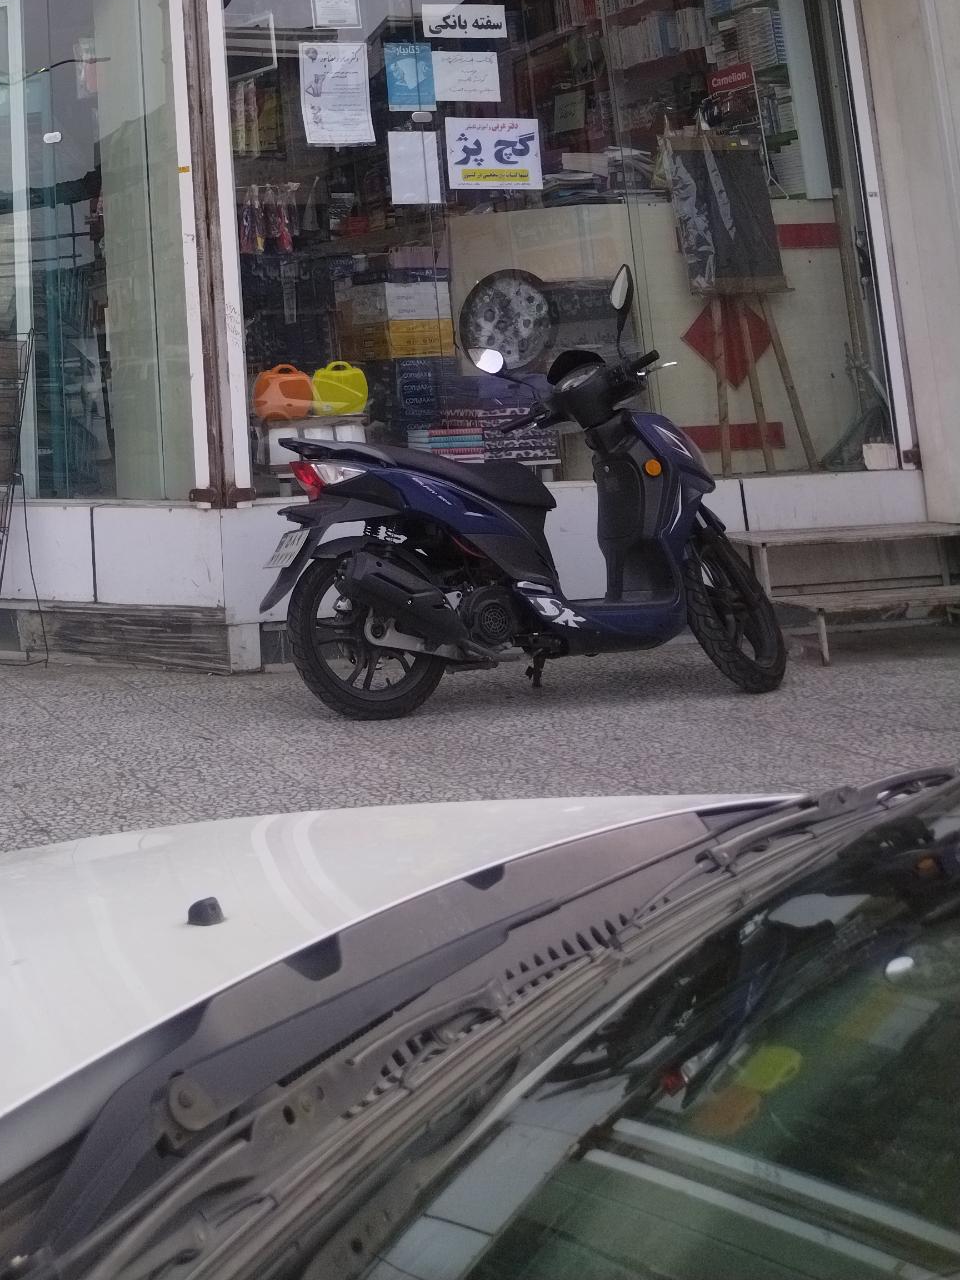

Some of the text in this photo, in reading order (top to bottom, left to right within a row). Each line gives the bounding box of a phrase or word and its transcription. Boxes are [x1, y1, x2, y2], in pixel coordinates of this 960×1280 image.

[428, 14, 503, 35] سفته بانکی
[711, 71, 747, 88] Camelion
[454, 132, 535, 167] گچ پژ
